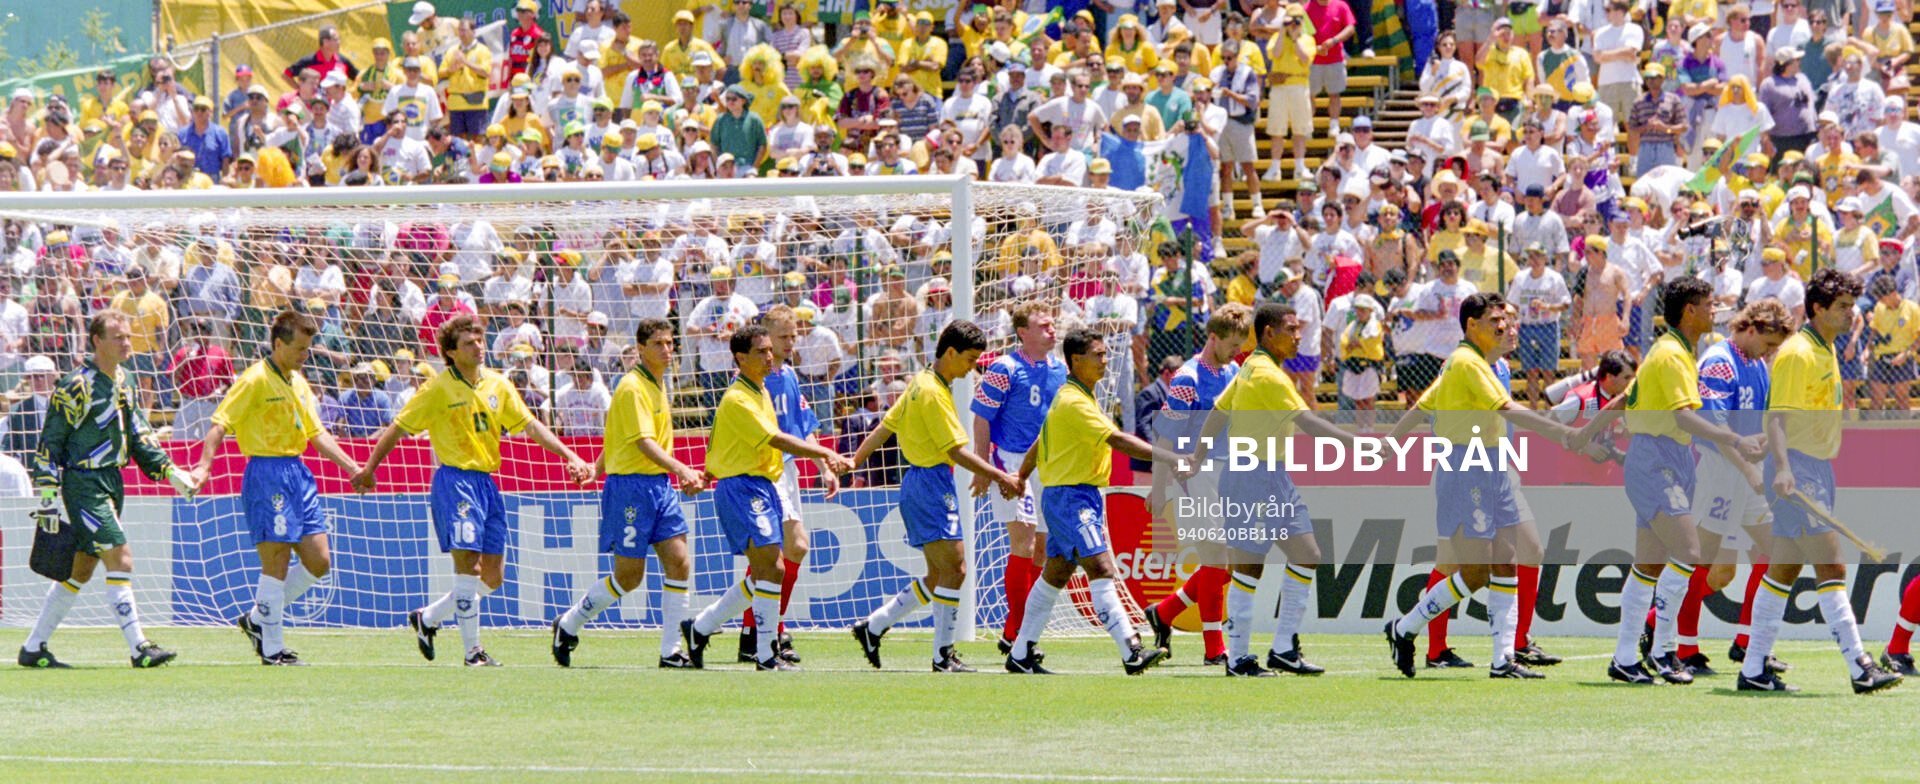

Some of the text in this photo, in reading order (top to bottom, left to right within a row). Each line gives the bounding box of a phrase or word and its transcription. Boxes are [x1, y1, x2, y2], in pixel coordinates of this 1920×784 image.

[1030, 384, 1041, 407] 6
[1739, 387, 1754, 409] 22
[273, 513, 288, 537] 8
[453, 520, 476, 544] 16
[755, 515, 773, 537] 9
[947, 512, 960, 536] 7
[622, 526, 638, 549] 2
[1078, 522, 1103, 550] 11
